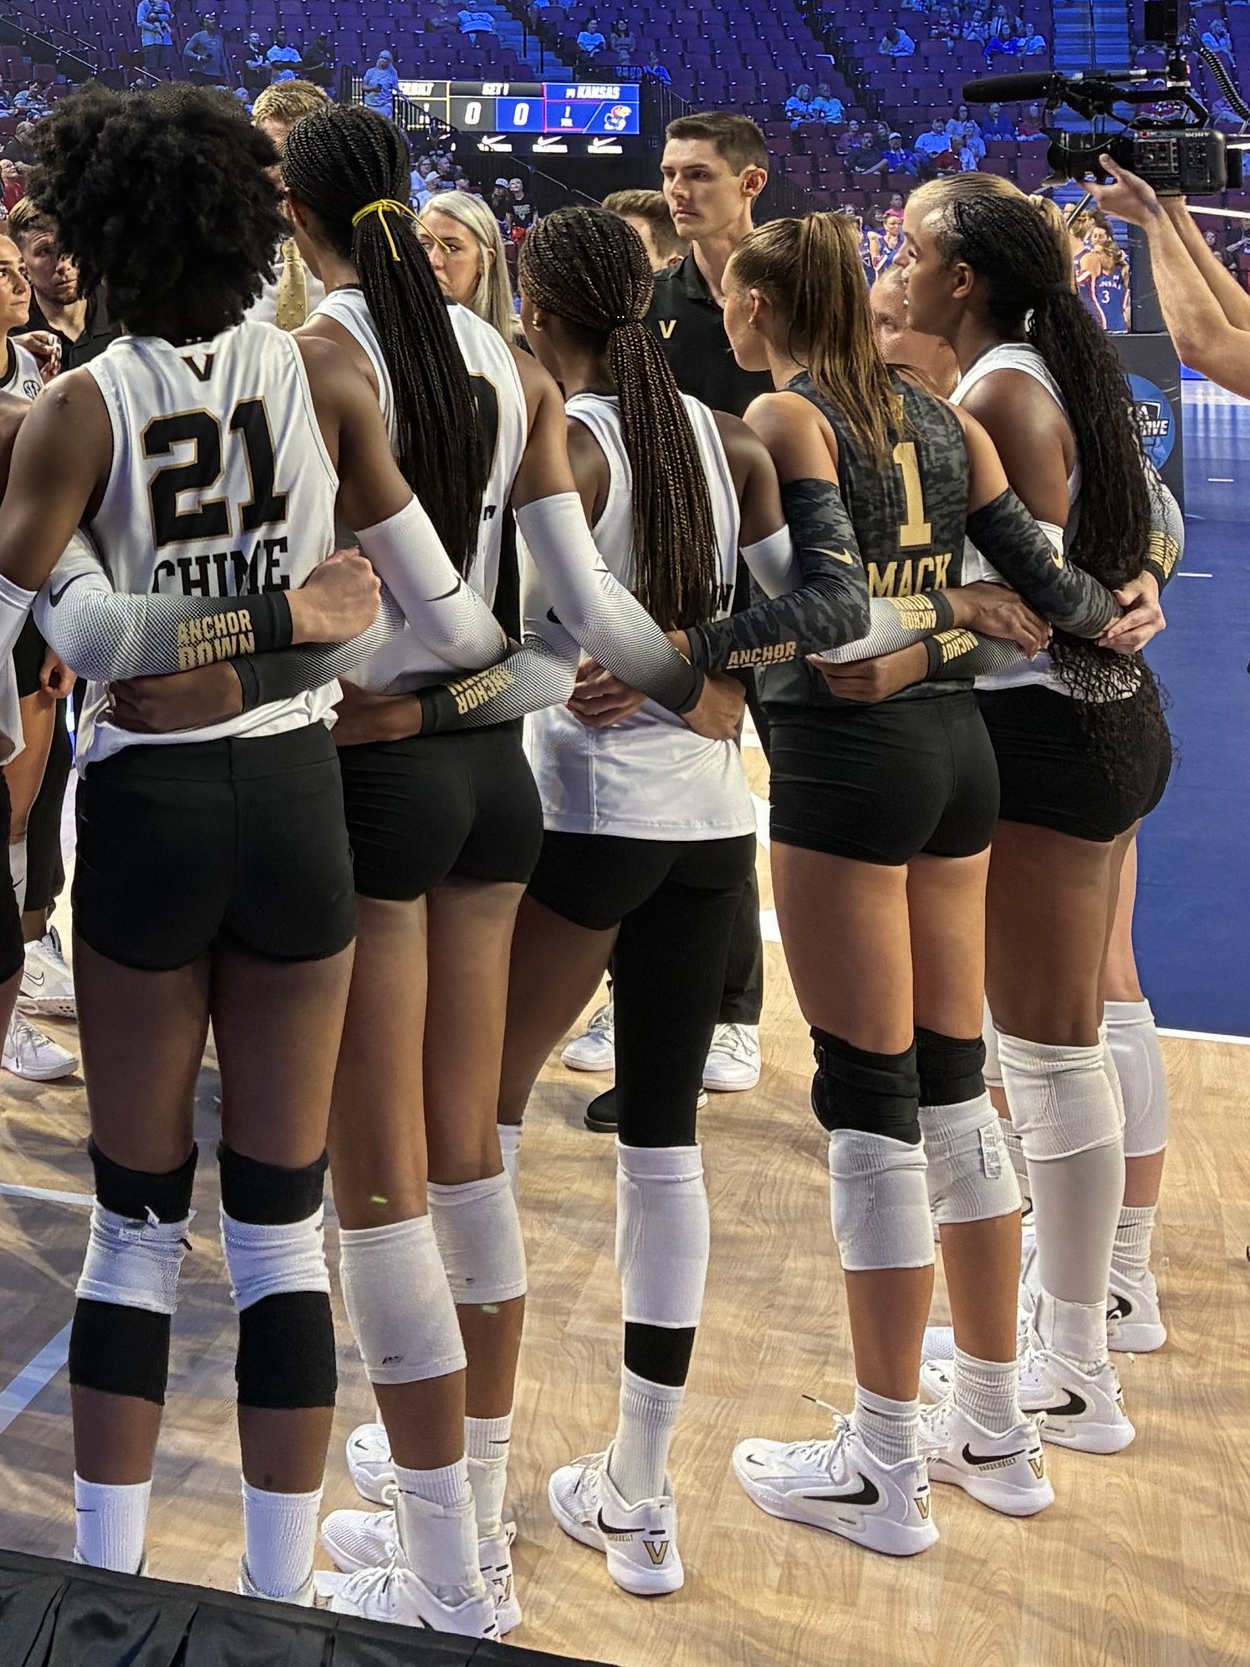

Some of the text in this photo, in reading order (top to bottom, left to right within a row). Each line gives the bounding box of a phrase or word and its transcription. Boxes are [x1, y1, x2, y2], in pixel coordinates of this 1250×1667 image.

[577, 86, 621, 99] KANSAS
[464, 101, 482, 125] 0
[513, 102, 530, 126] 0
[1101, 290, 1110, 304] 3
[658, 319, 677, 340] V
[183, 353, 216, 382] V
[140, 395, 289, 551] 21
[892, 441, 932, 547] 1
[867, 553, 953, 598] MACK
[177, 608, 252, 645] ANCHOR
[899, 609, 937, 630] ANCHOR
[178, 631, 256, 671] DOWN
[728, 641, 797, 666] ANCHOR
[643, 1540, 670, 1565] V
